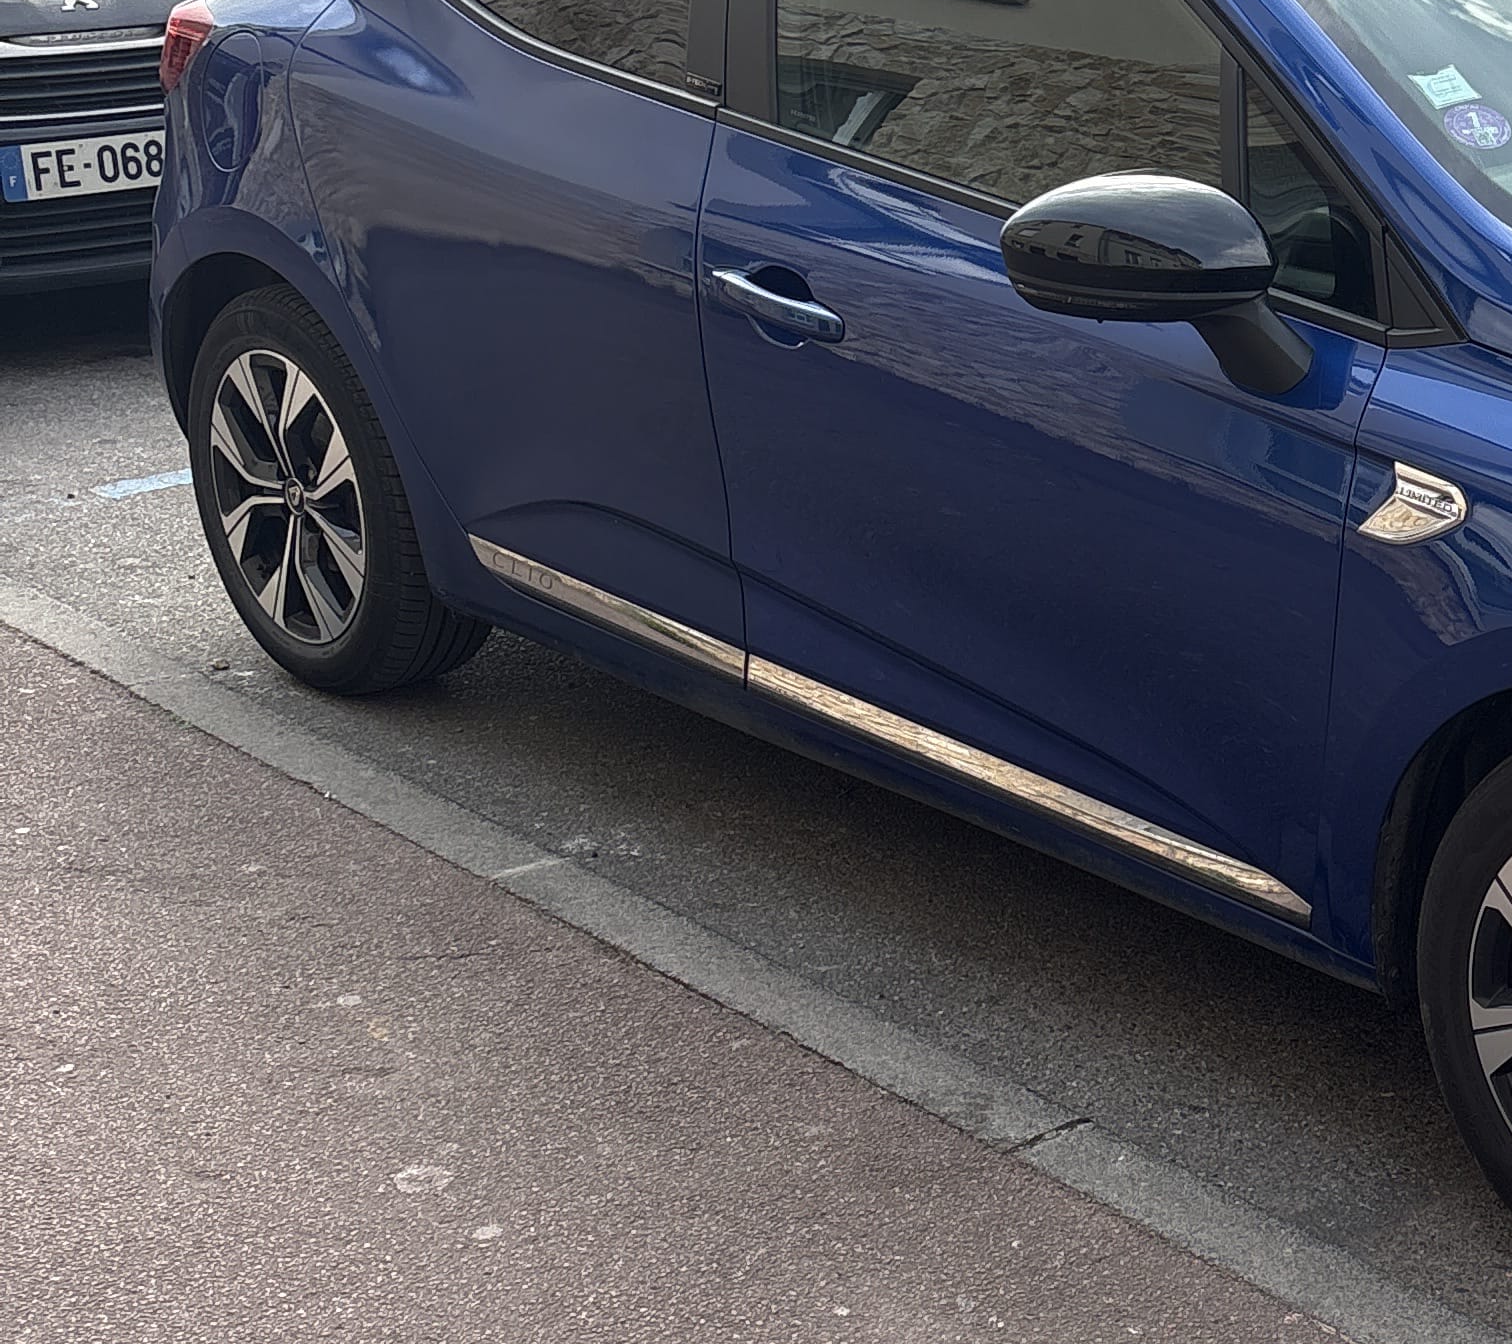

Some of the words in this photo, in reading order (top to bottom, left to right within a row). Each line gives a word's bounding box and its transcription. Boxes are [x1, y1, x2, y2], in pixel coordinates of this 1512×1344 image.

[9, 176, 17, 188] F
[31, 140, 163, 192] FE-068
[1400, 486, 1453, 513] LIMITED
[492, 550, 553, 591] CLIO
